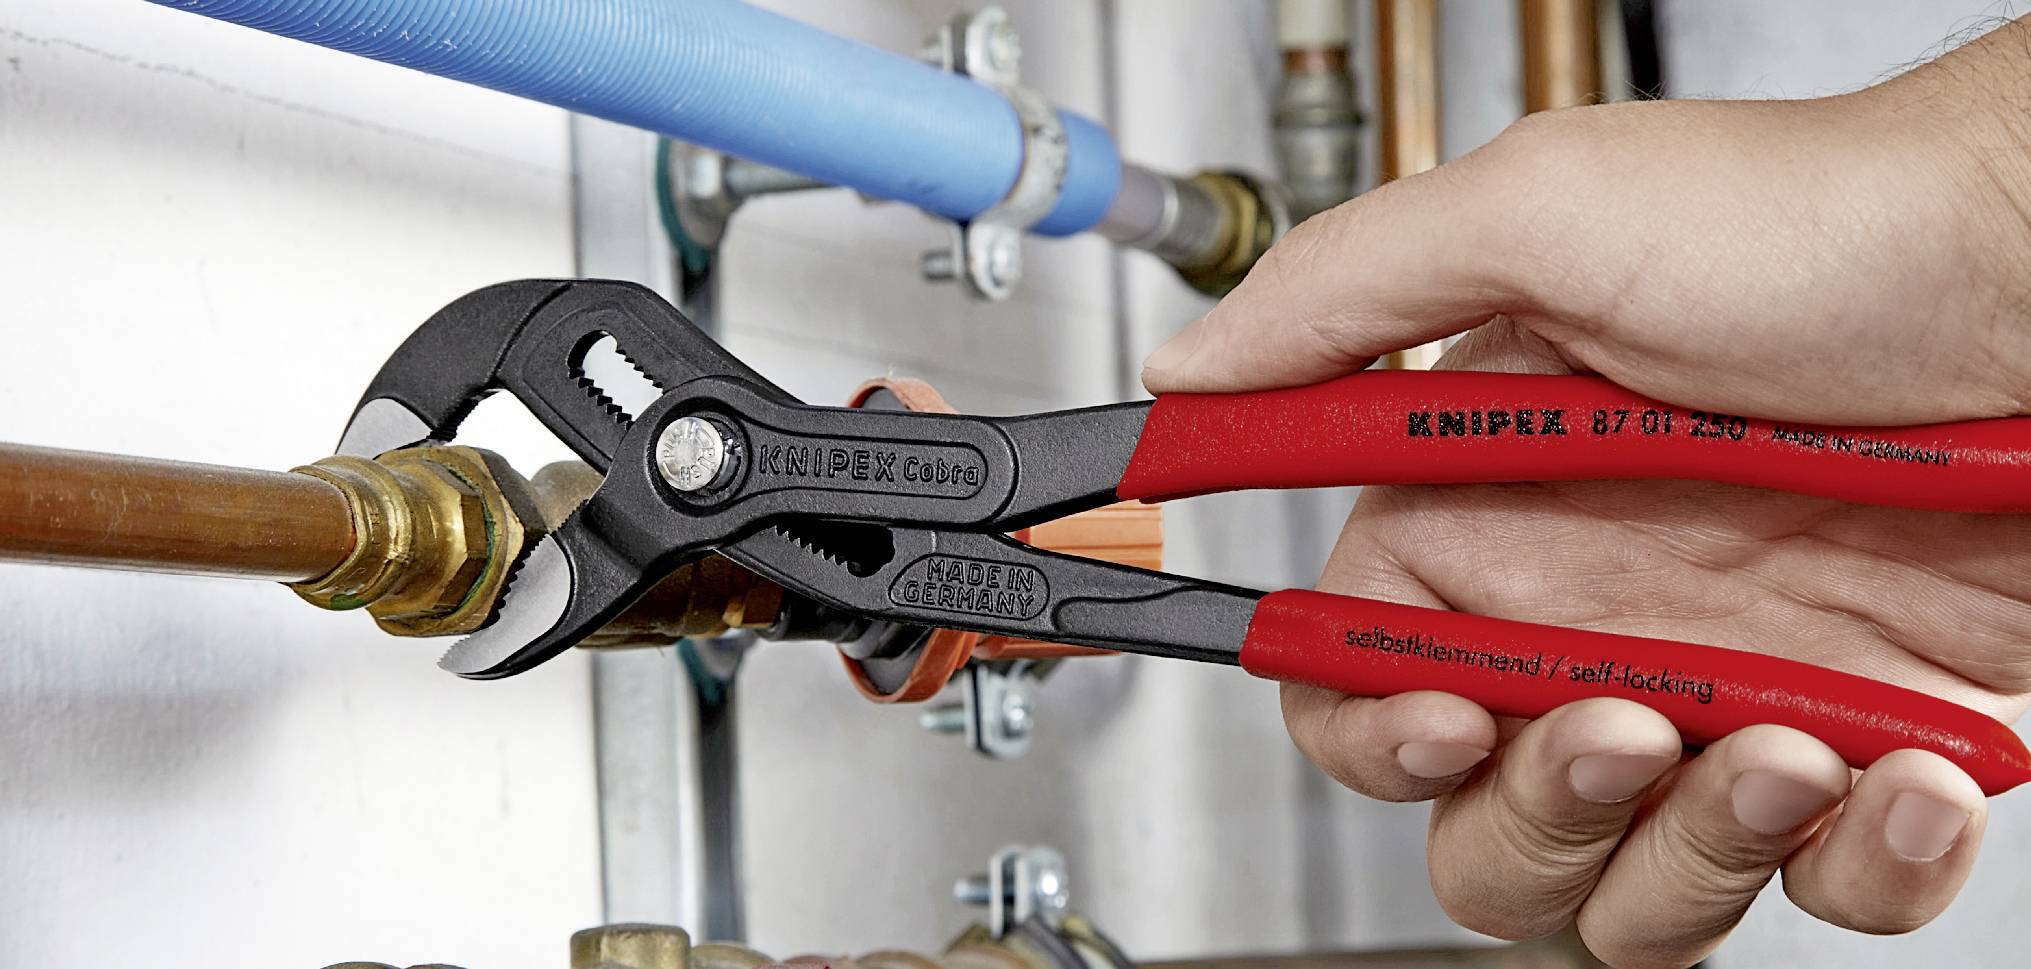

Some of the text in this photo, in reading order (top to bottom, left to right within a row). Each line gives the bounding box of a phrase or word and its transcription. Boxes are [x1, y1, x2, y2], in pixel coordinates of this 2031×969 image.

[1408, 410, 1747, 441] KNIPEX 87 01 250
[1772, 426, 1951, 466] MADE IN GERMANY
[759, 445, 979, 486] KNIPEX Cobra
[927, 558, 1034, 592] MADE IN
[904, 581, 1034, 616] GERMANY
[1345, 627, 1543, 676] selbstklemmend
[1569, 660, 1713, 704] self-locking
